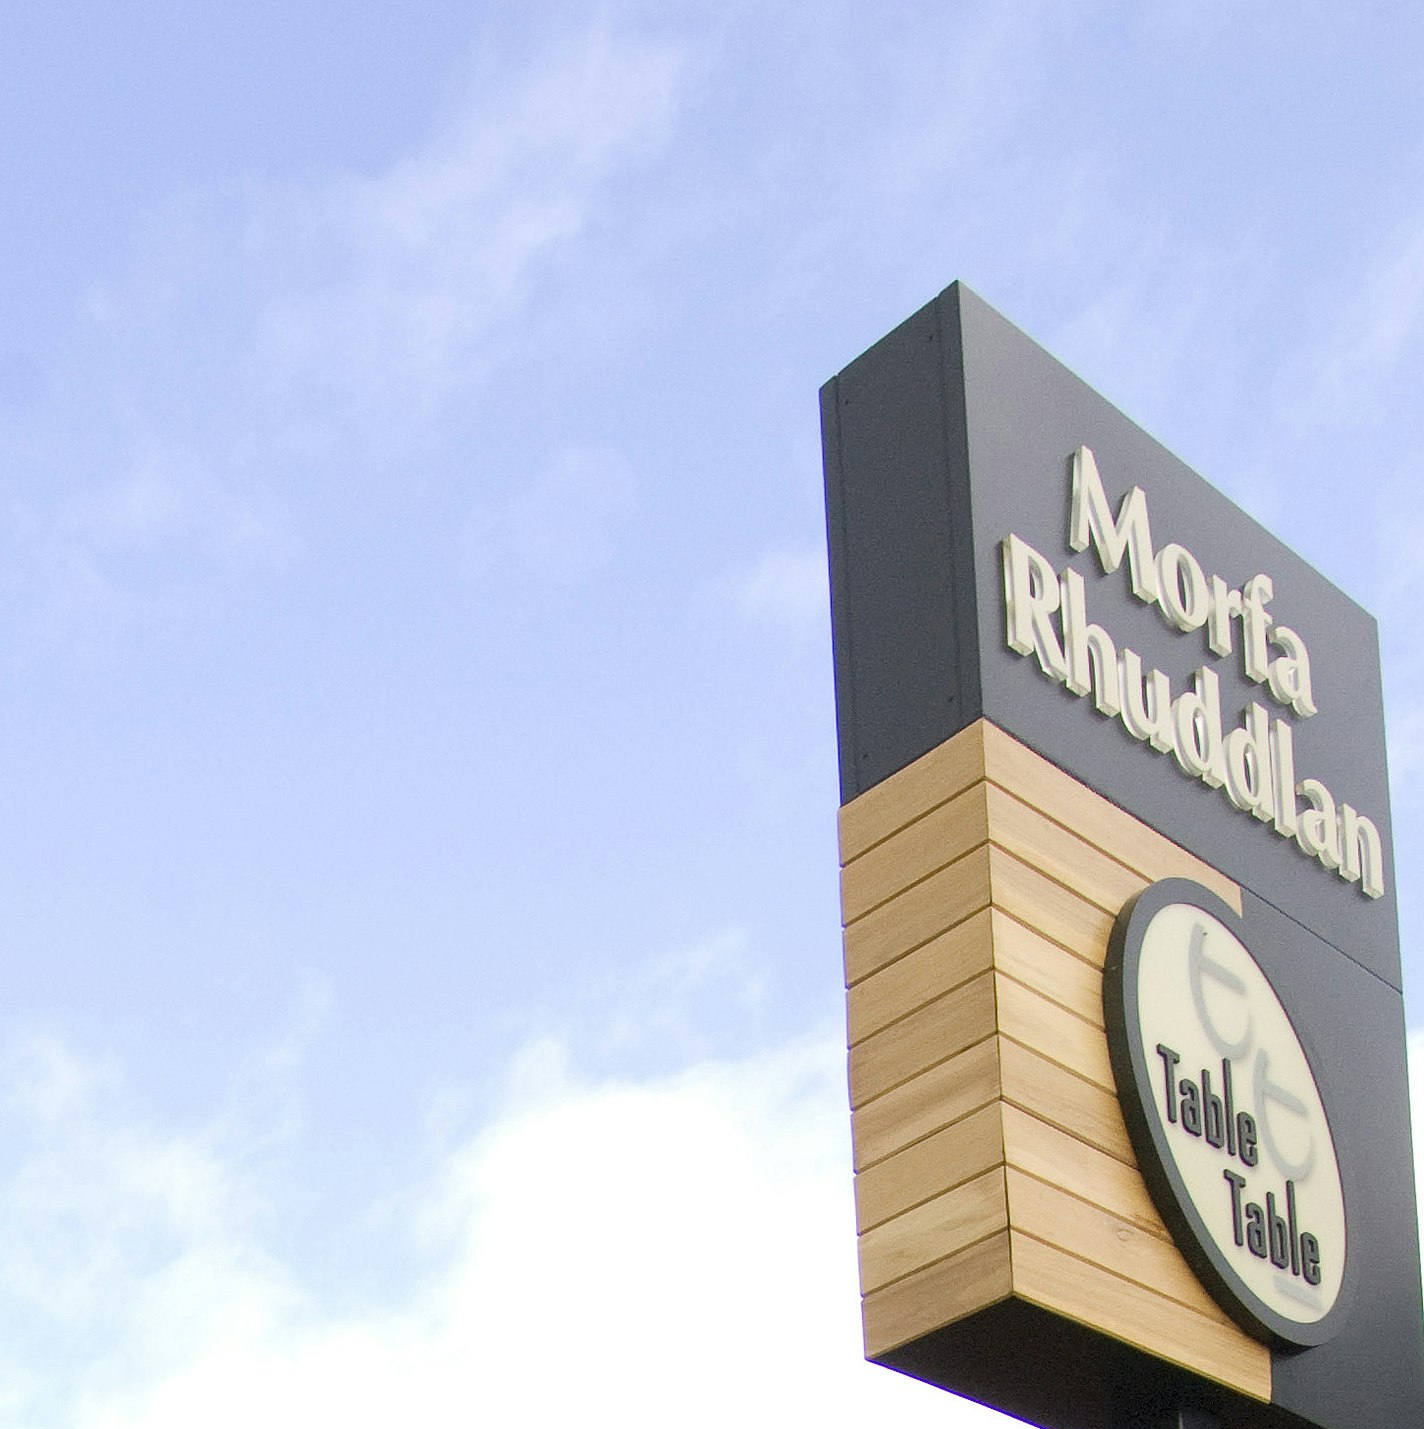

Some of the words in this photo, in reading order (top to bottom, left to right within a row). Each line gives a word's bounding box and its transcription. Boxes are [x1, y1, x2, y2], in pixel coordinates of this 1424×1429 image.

[1070, 444, 1318, 718] Morfa
[1002, 532, 1385, 899] Rhuddlan
[1156, 1043, 1259, 1168] Table
[1223, 1168, 1322, 1287] Table
